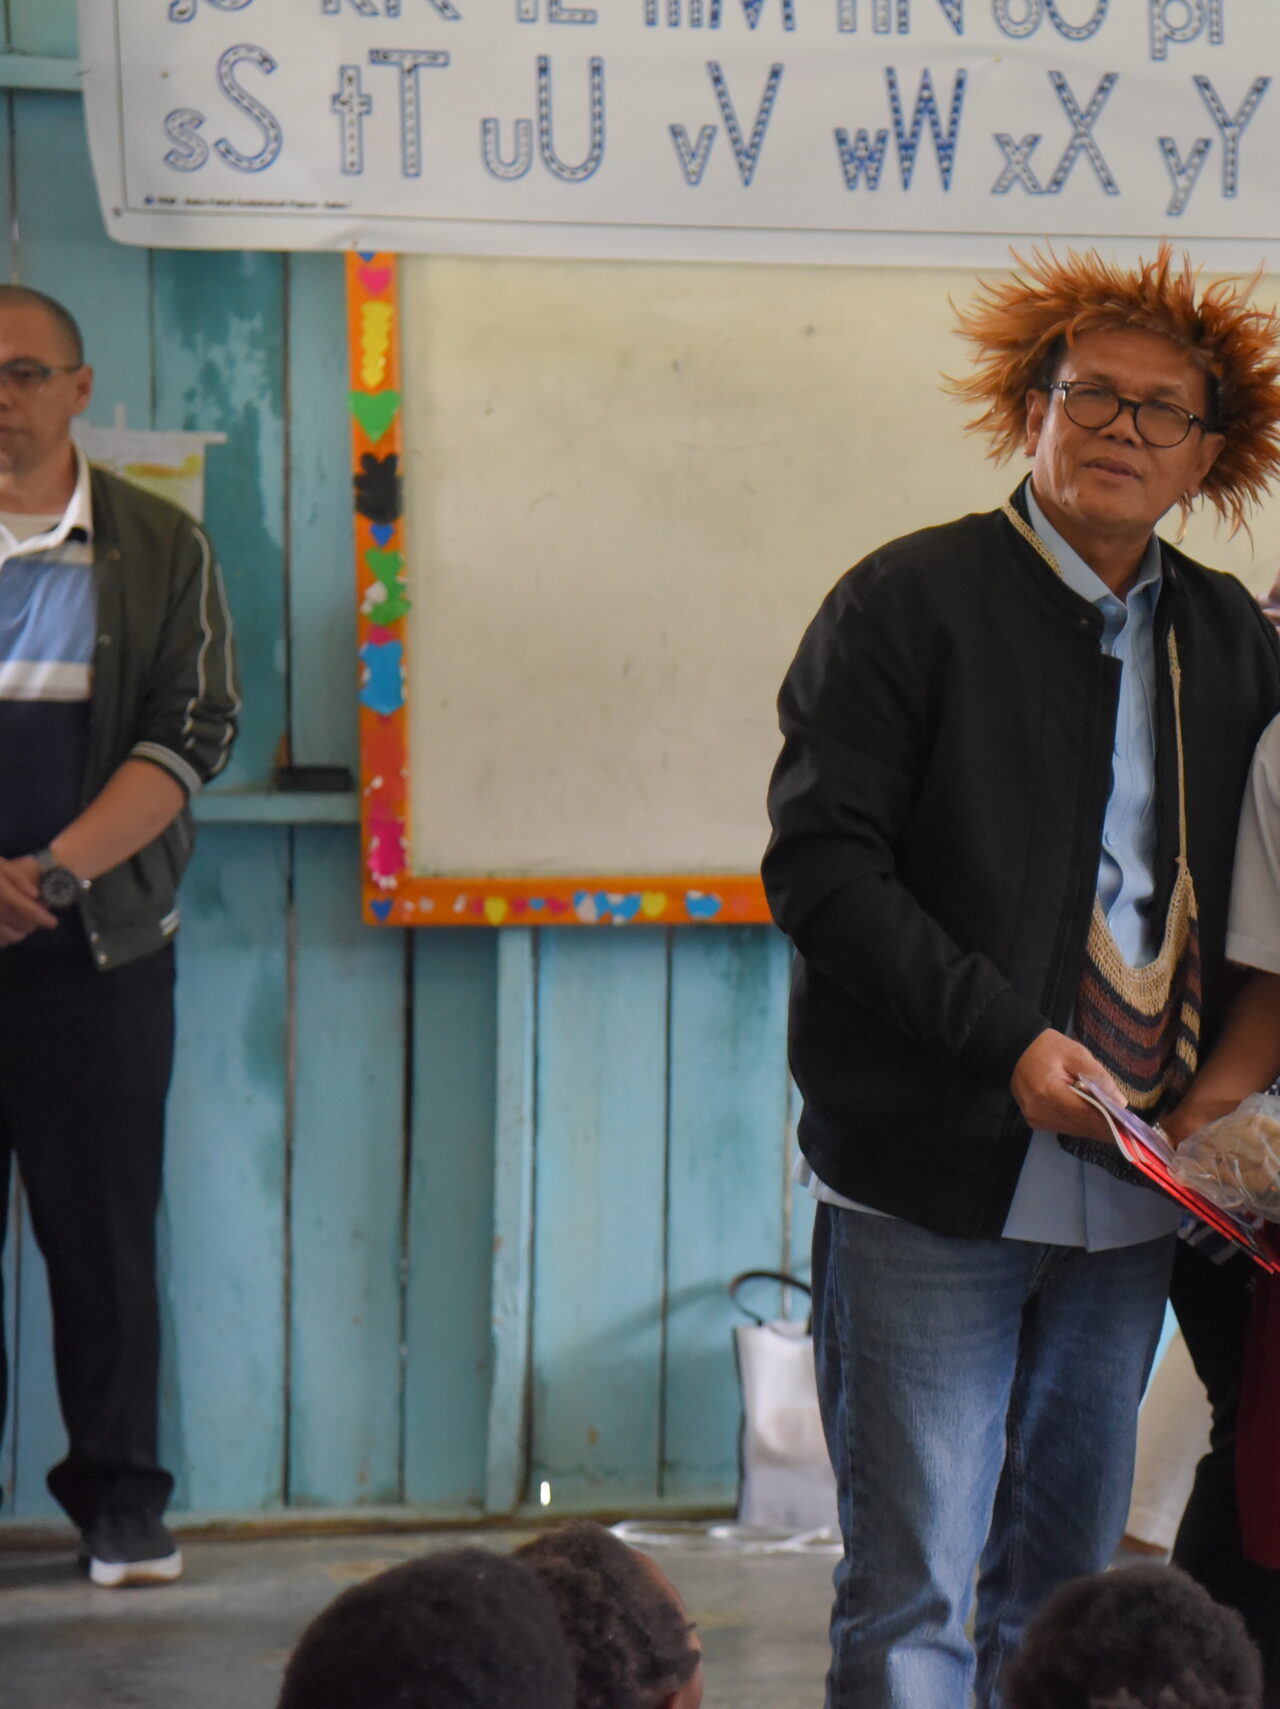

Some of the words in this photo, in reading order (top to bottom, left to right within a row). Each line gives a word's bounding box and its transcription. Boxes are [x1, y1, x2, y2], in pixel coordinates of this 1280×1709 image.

[163, 44, 282, 172] sS
[331, 48, 449, 177] tT
[480, 55, 604, 181] uU
[670, 61, 784, 187] vV
[834, 66, 967, 191] wW
[991, 70, 1120, 195] xX
[1157, 73, 1272, 216] yY
